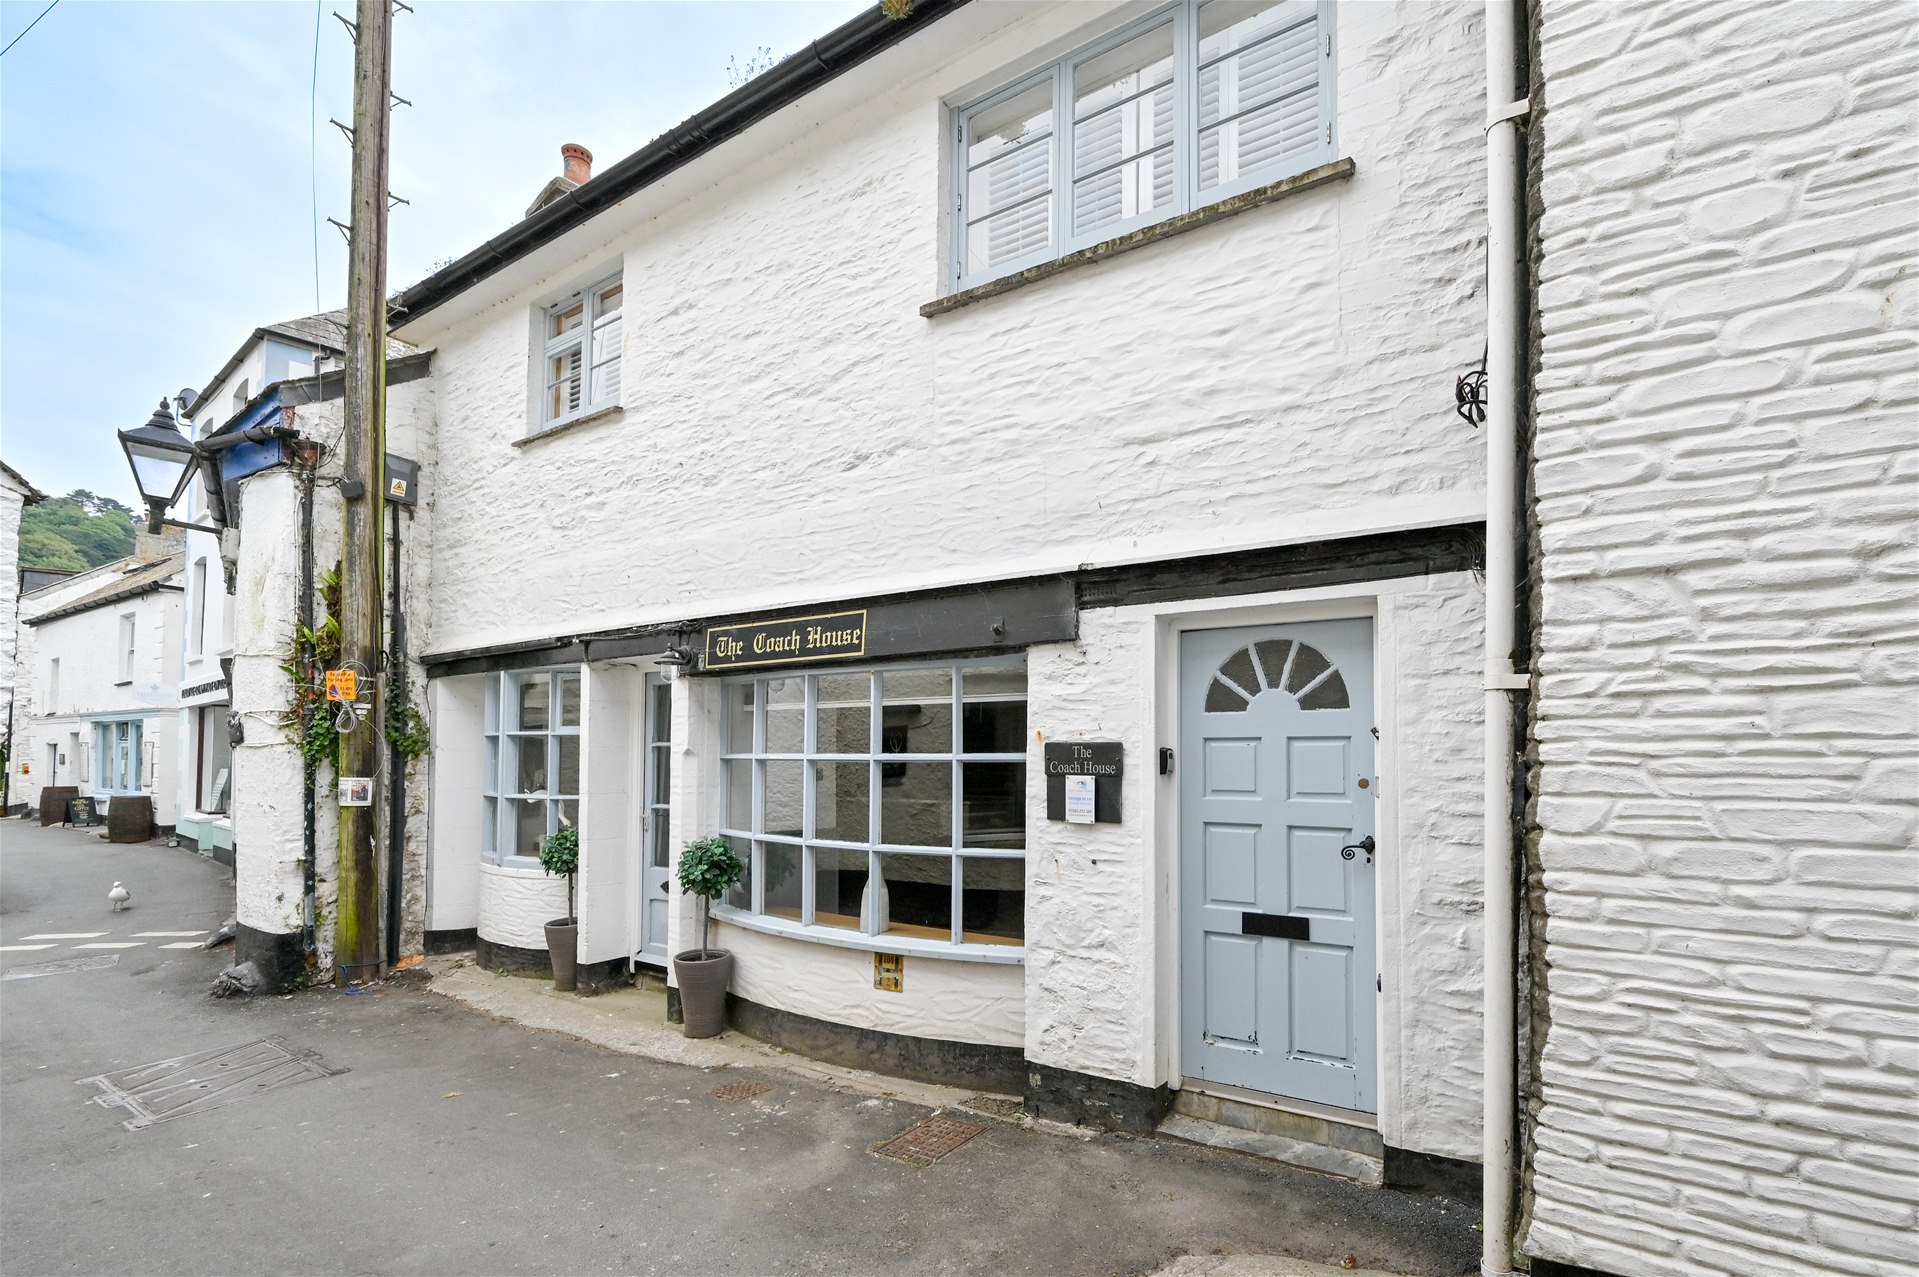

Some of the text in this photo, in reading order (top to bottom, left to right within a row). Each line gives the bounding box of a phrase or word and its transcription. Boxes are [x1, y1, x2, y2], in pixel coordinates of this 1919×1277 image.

[716, 626, 860, 661] The Coach House
[1072, 745, 1093, 758] The
[1049, 760, 1116, 775] Coach House
